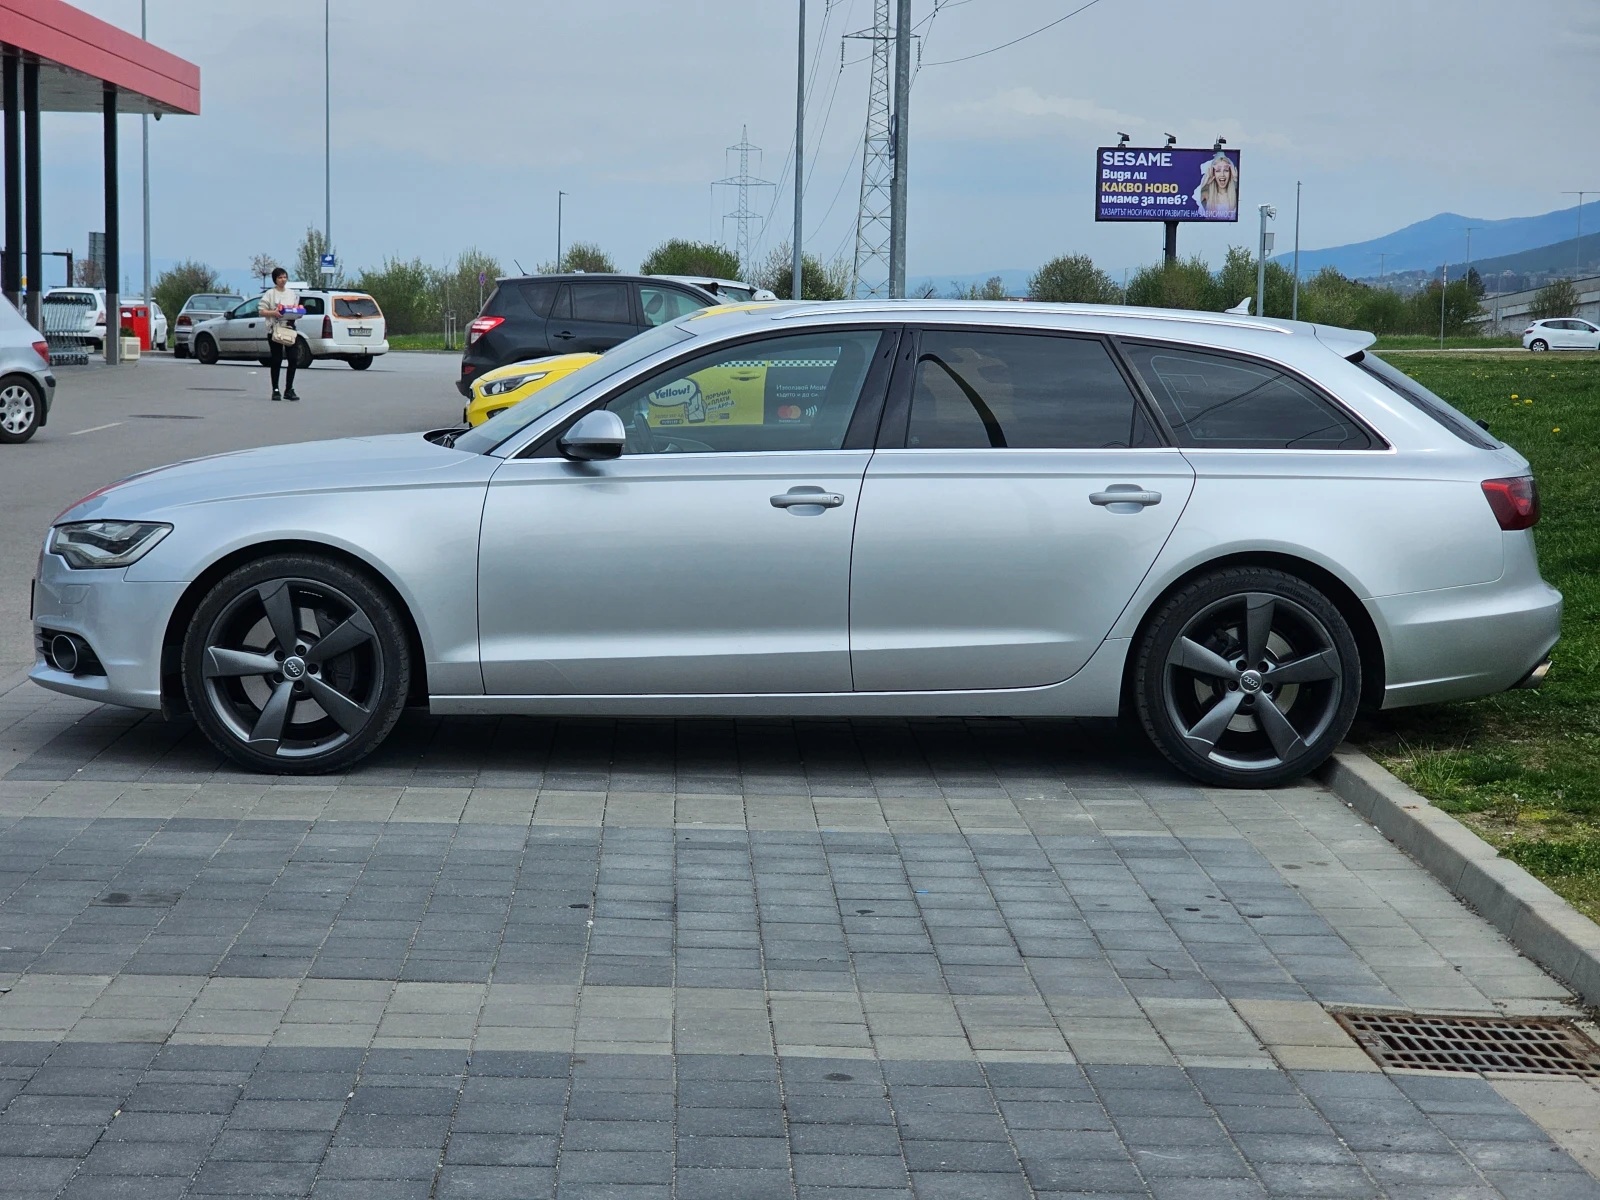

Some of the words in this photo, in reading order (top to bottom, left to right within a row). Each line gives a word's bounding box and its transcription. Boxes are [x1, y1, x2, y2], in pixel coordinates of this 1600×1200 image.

[1102, 169, 1131, 181] Видя
[1133, 171, 1147, 180] ли
[1102, 182, 1142, 193] КАКВО
[1145, 183, 1178, 194] НОВО
[1101, 194, 1139, 204] имаме
[1140, 196, 1154, 207] за
[1156, 194, 1188, 205] теб?
[1101, 208, 1127, 216] ХАЗАРТЪТ
[1143, 209, 1157, 217] РИСК
[1157, 209, 1165, 217] ОТ
[1165, 209, 1191, 217] РАЗВИТИЕ
[1191, 210, 1199, 218] НА
[654, 384, 691, 400] Yellow!
[705, 388, 732, 400] ПОРЪЧАЙ
[711, 396, 730, 406] ПЛАТИ
[1276, 582, 1321, 609] Continental
